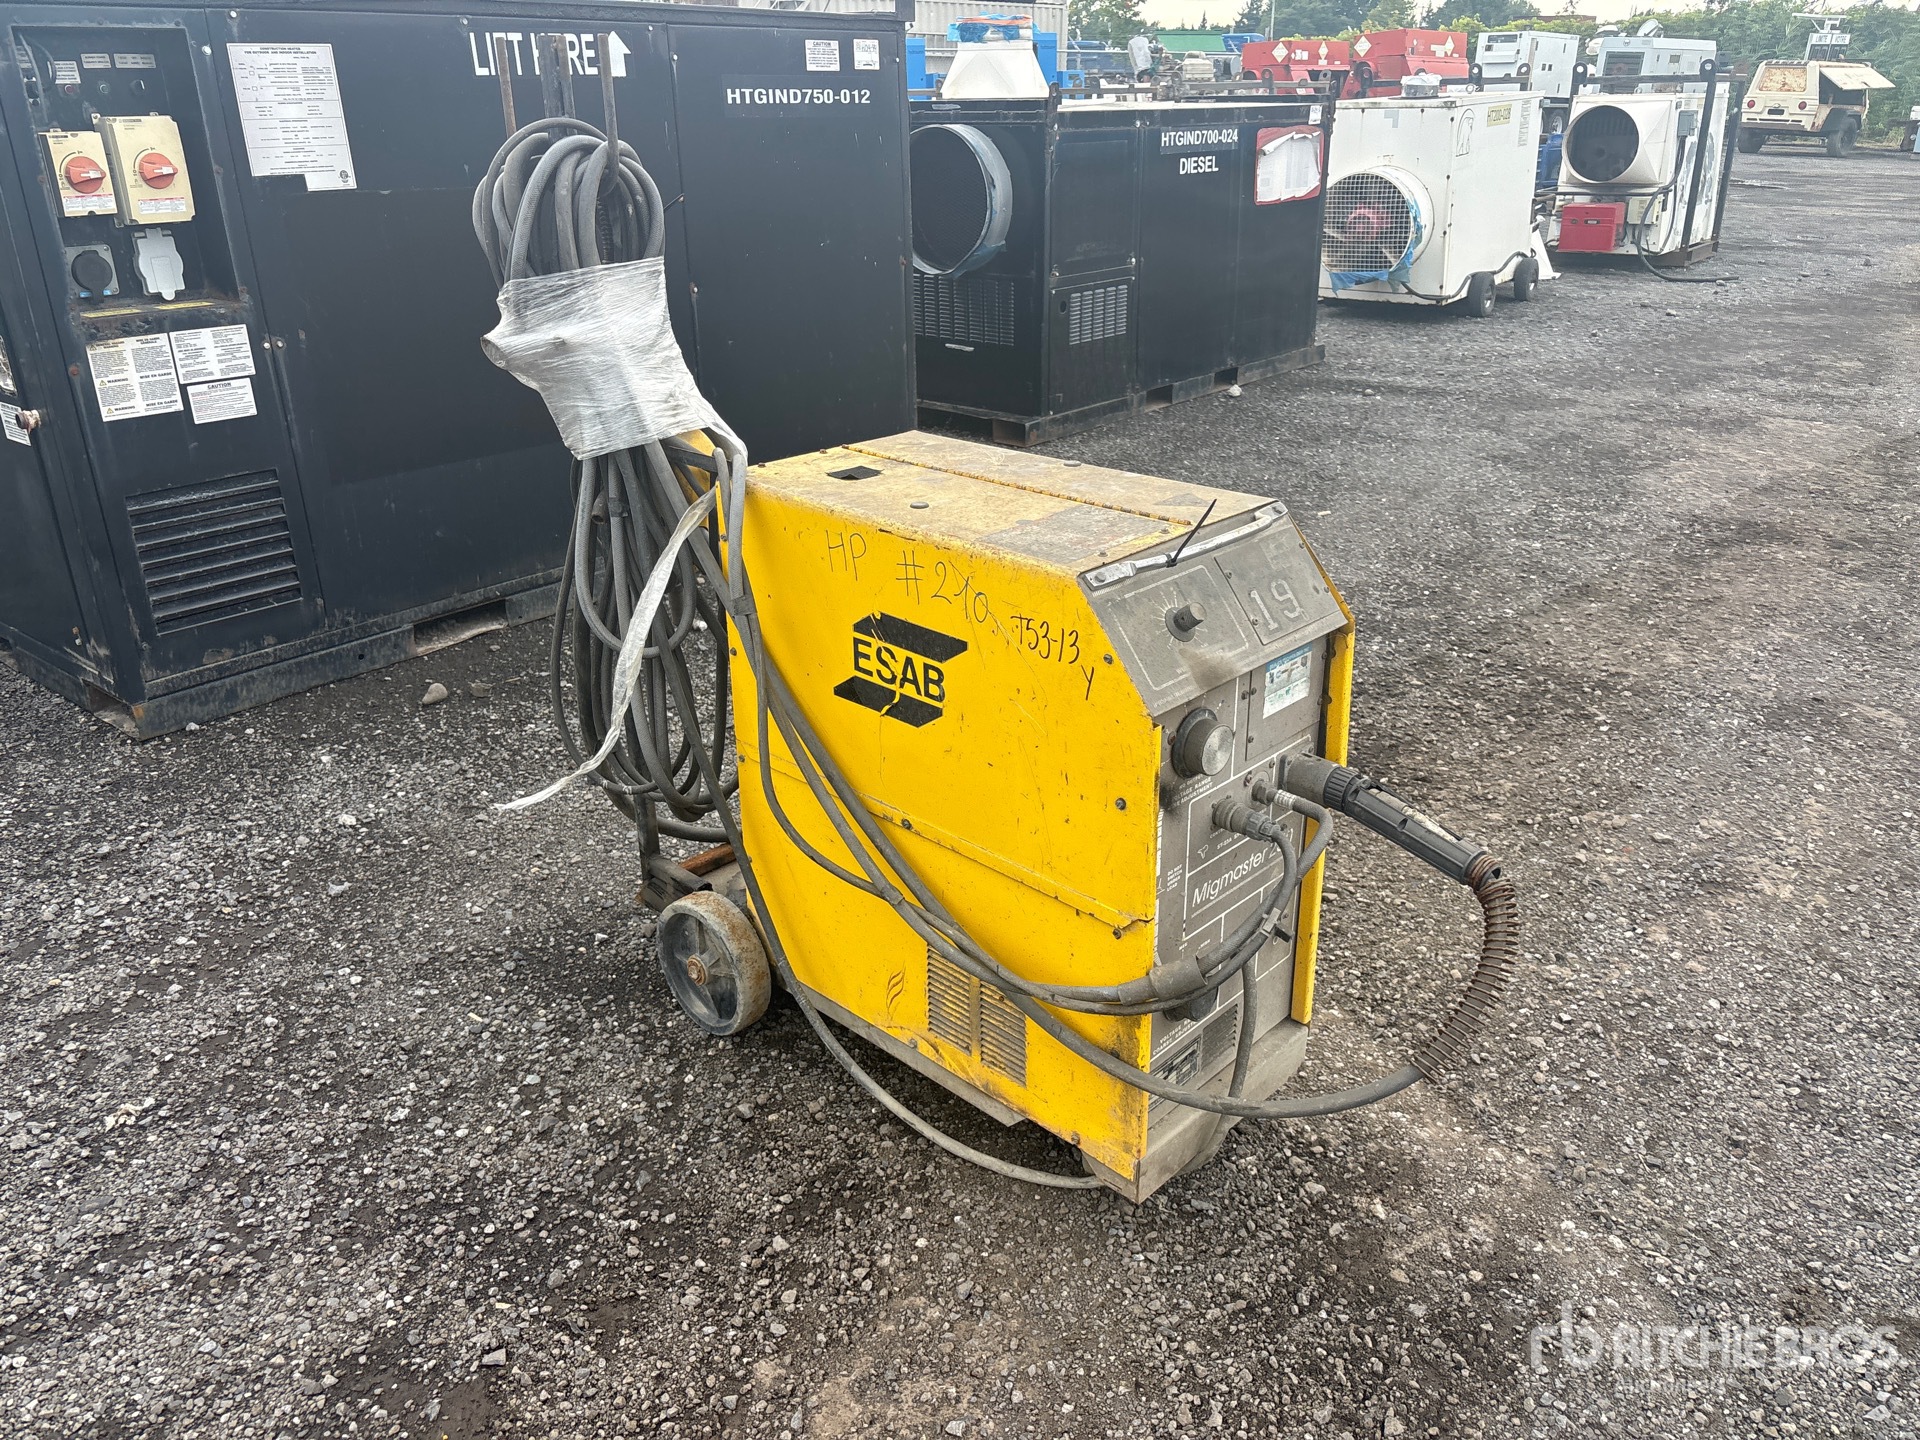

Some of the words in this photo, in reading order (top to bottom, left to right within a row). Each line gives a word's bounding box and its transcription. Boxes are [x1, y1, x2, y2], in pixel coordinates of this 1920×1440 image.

[529, 32, 599, 76] HRE
[726, 88, 871, 104] HTGIND750-012
[1161, 129, 1239, 147] HTGIND700-024
[1179, 156, 1219, 175] DIESEL
[1250, 578, 1301, 631] 19
[852, 636, 946, 703] ESAB
[1172, 786, 1194, 801] OLTAGE
[1194, 776, 1212, 790] RANGE
[1180, 782, 1214, 804] ADJUSTMENT
[1192, 847, 1269, 908] Migmaster
[1159, 1024, 1182, 1044] VOLTAGE
[1152, 1037, 1174, 1055] COARSE
